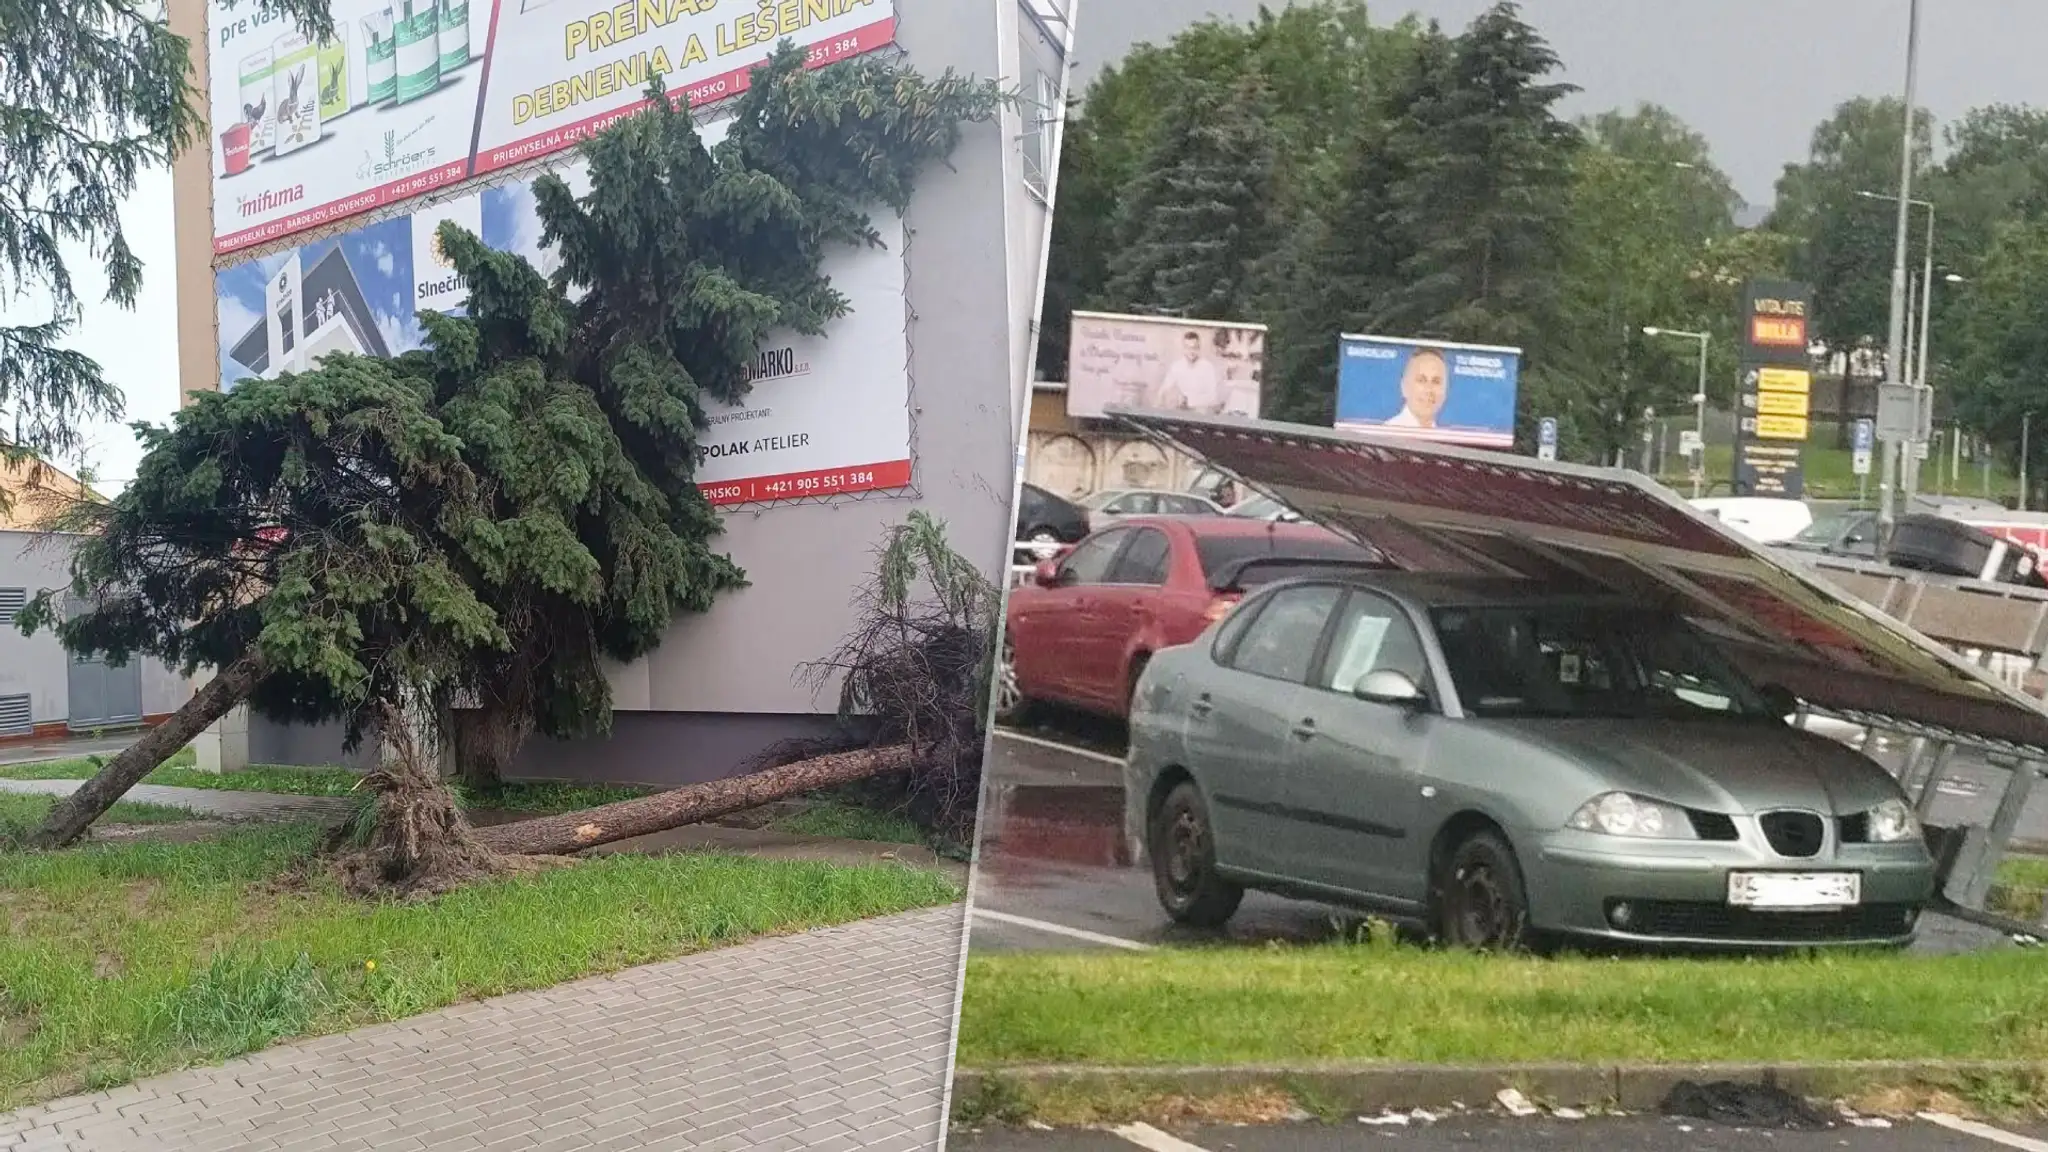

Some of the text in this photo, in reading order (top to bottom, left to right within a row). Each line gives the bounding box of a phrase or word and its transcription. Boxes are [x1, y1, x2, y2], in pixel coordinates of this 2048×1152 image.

[221, 19, 247, 48] pre
[834, 36, 858, 54] 384
[512, 45, 673, 126] DEBNENIA
[680, 33, 708, 69] A
[242, 183, 304, 218] mifuma
[329, 193, 376, 217] SLOVENSKO
[391, 182, 410, 196] +421
[412, 177, 427, 189] 905
[428, 172, 444, 185] 551
[446, 166, 461, 179] 384
[753, 432, 809, 453] ATELIER
[764, 480, 793, 493] +421
[797, 477, 819, 490] 905
[823, 474, 846, 487] 551
[850, 471, 874, 485] 384
